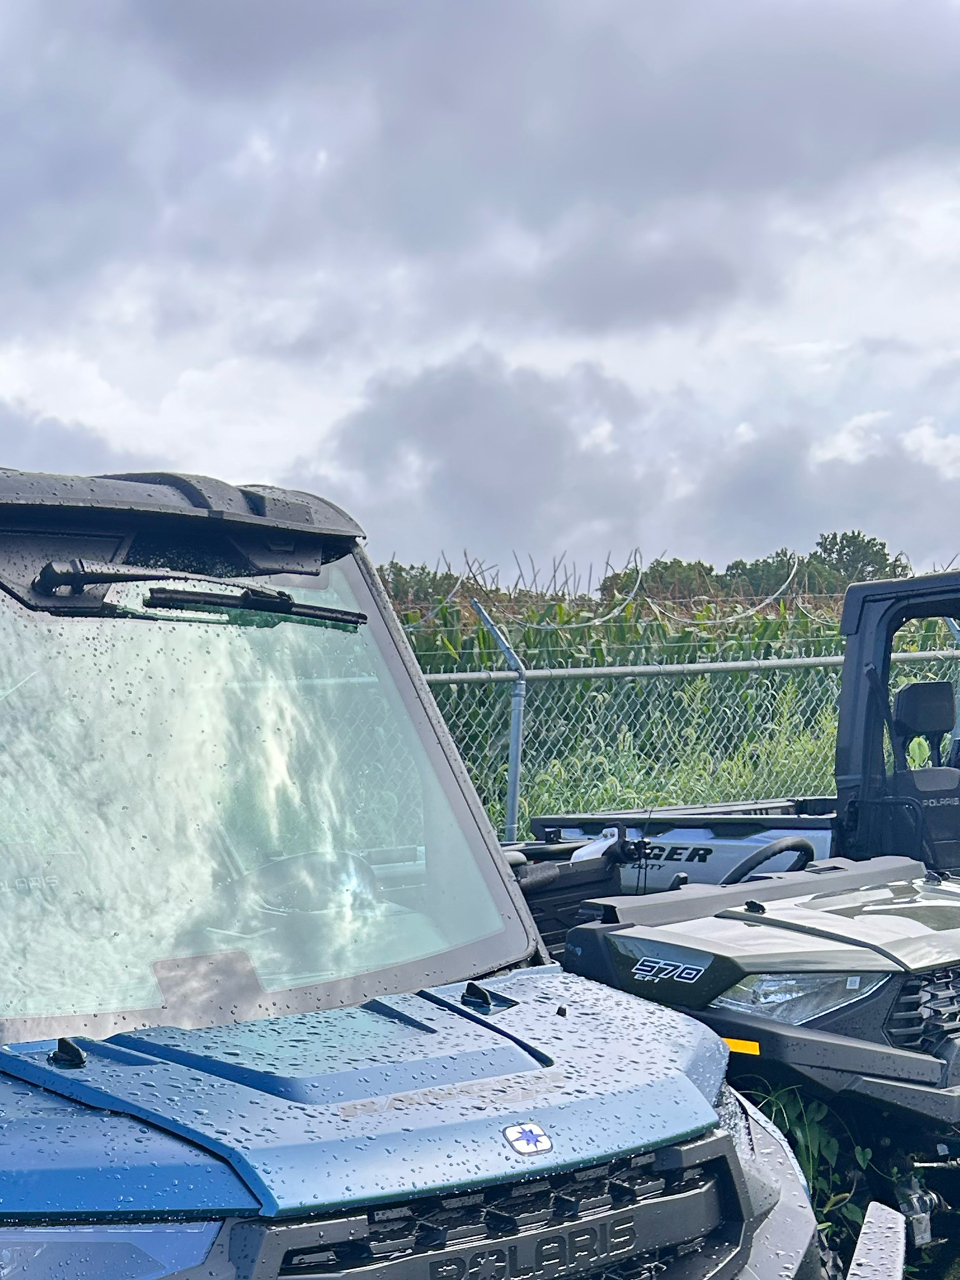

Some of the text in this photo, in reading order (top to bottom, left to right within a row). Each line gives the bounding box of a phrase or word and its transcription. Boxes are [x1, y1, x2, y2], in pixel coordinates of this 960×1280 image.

[923, 798, 960, 806] POLARIS
[631, 957, 705, 983] 570
[634, 974, 660, 983] EFI
